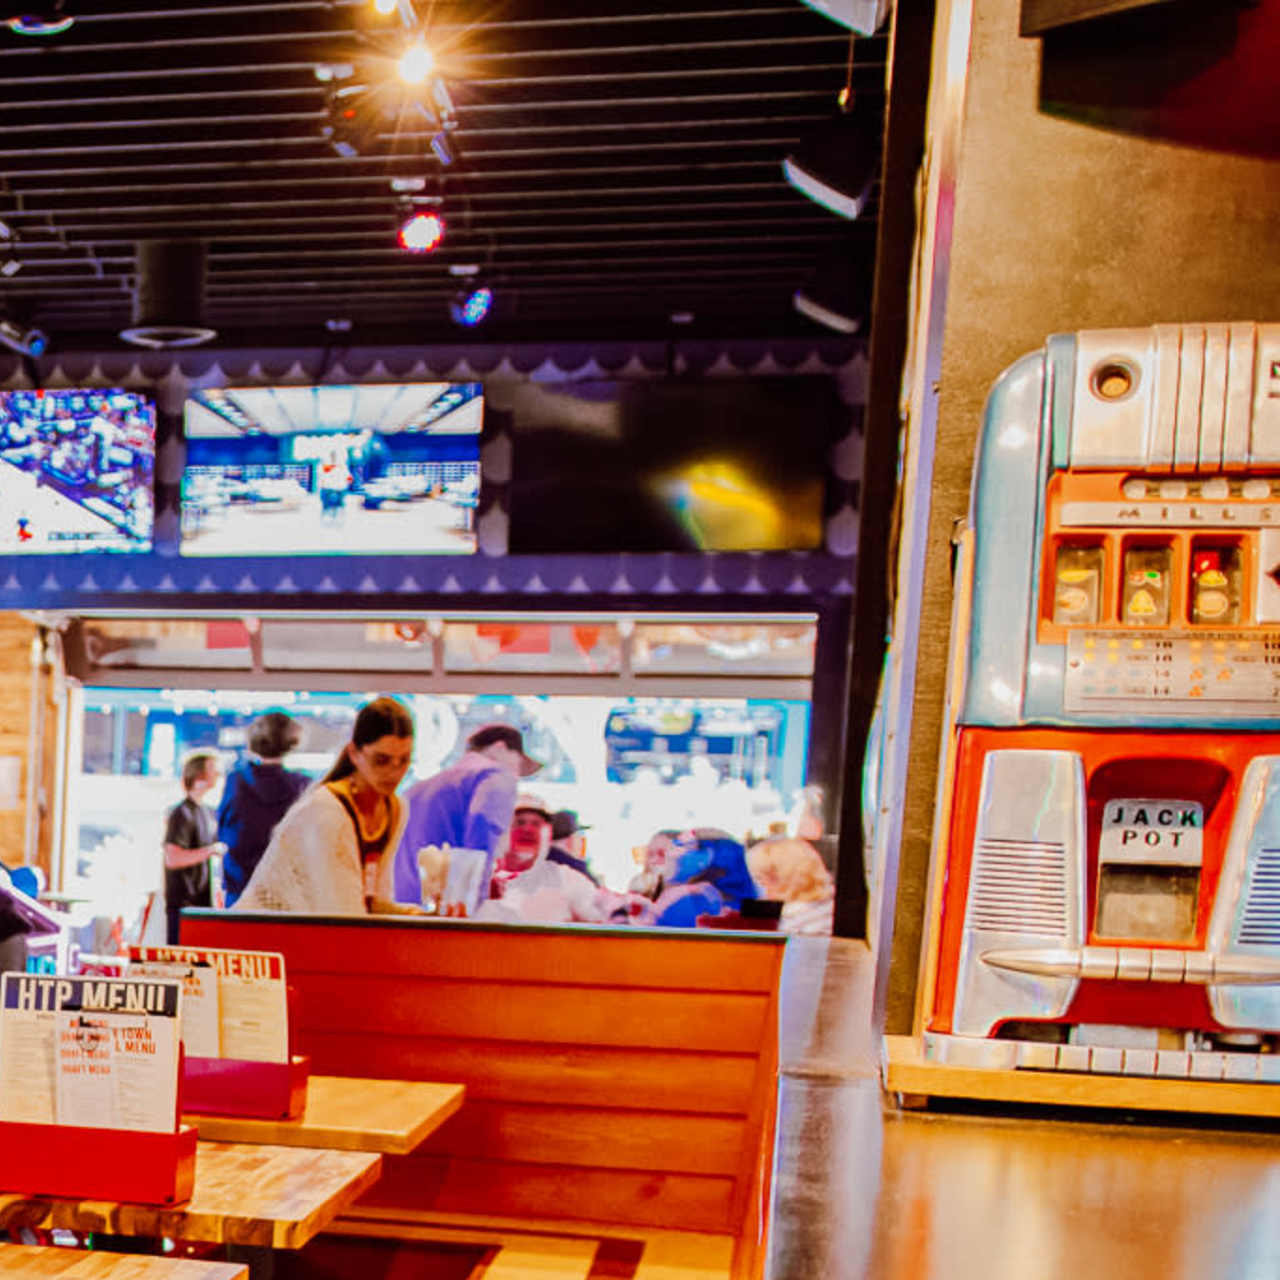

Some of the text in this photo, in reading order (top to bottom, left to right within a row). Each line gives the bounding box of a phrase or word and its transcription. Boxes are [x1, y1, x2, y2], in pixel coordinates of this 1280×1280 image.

[1112, 807, 1197, 827] JACK
[1121, 830, 1184, 848] POT
[18, 978, 74, 1011] HTP
[82, 982, 166, 1011] MENU
